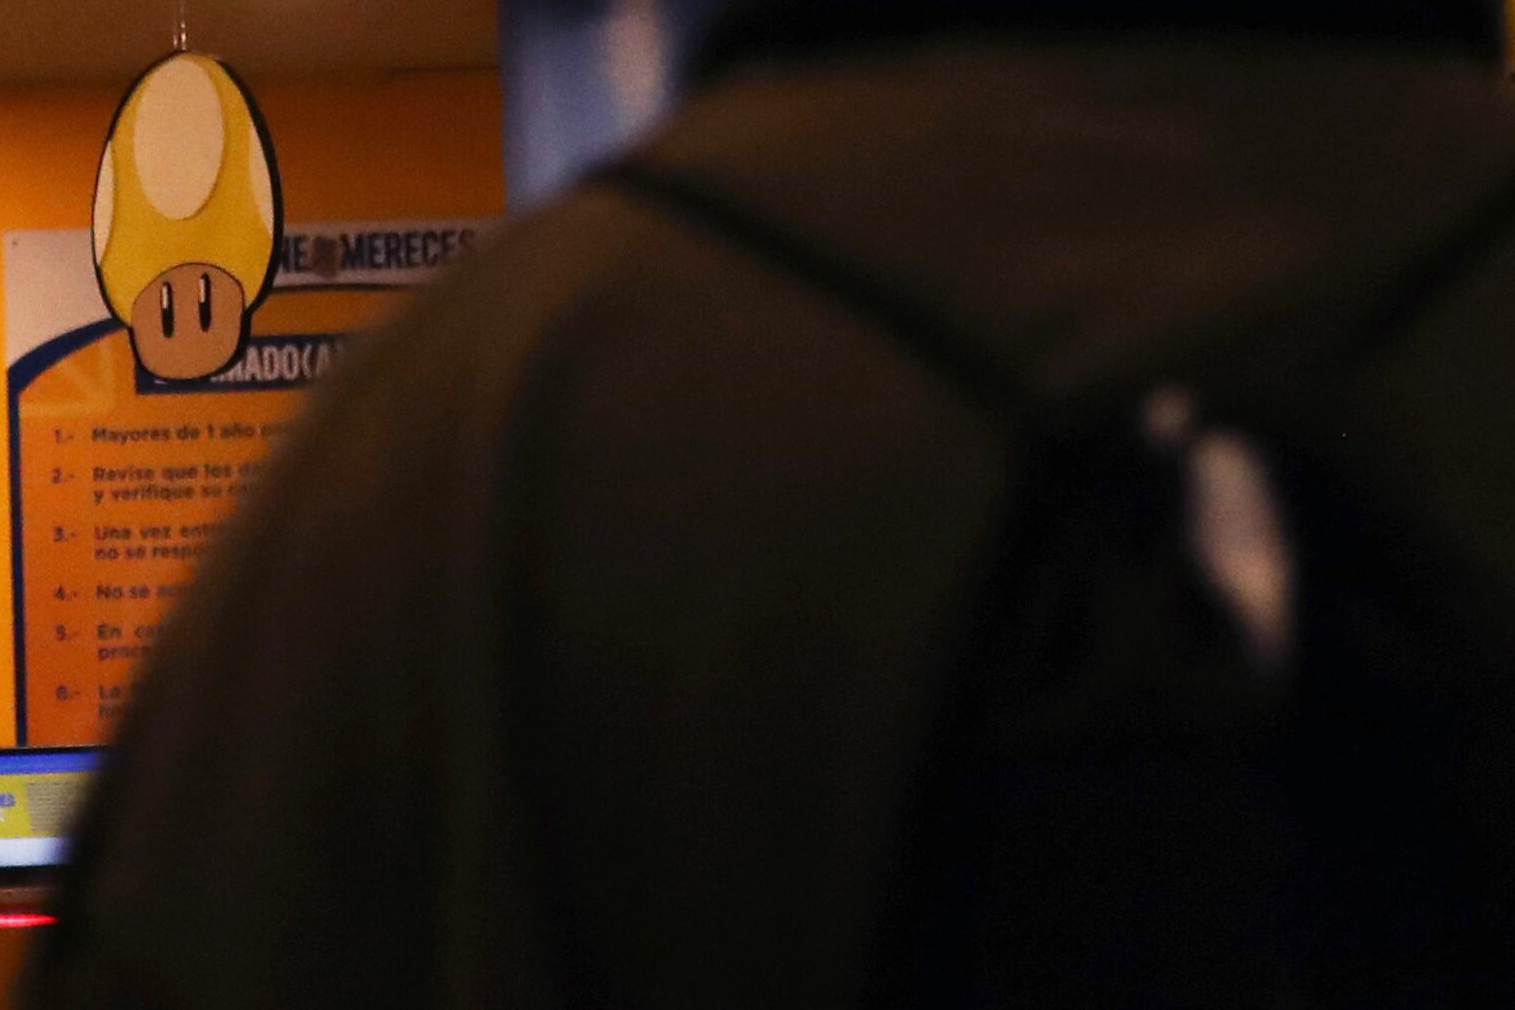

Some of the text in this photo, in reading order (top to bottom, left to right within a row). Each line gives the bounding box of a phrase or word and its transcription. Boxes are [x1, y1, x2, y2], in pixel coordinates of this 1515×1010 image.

[91, 427, 170, 445] Mayores
[176, 425, 200, 440] de
[220, 423, 255, 439] año
[92, 466, 156, 481] Revise
[161, 467, 198, 483] que
[203, 463, 231, 478] los
[93, 489, 104, 505] y
[111, 485, 194, 502] verifique
[94, 525, 132, 541] Una
[140, 527, 171, 539] vez
[94, 548, 119, 561] no
[125, 547, 146, 560] se
[96, 584, 123, 599] No
[130, 585, 150, 599] se
[97, 622, 122, 639] En
